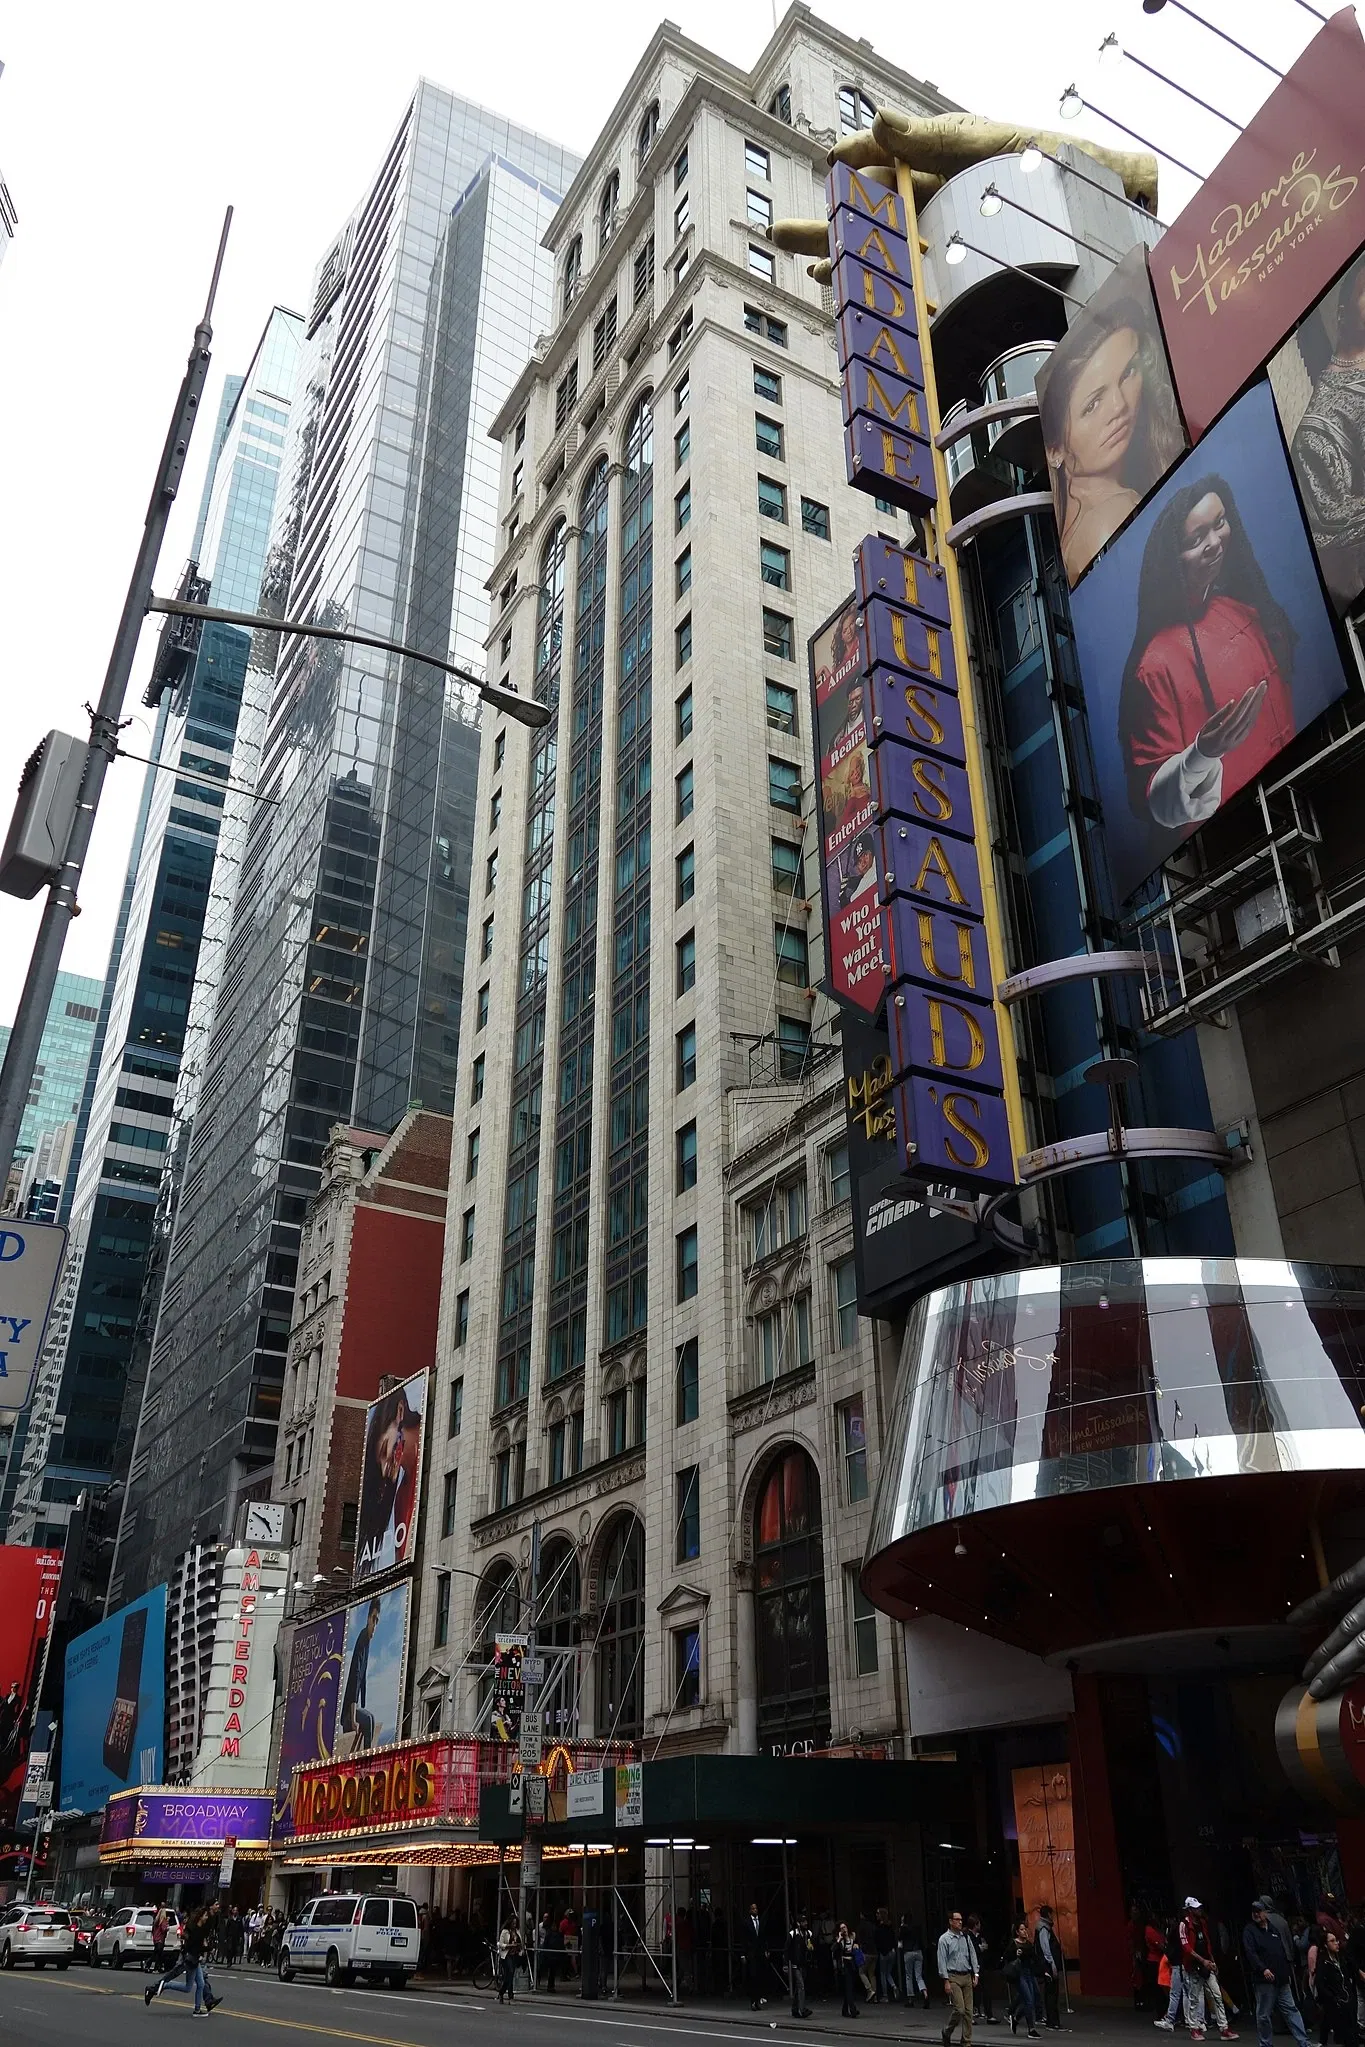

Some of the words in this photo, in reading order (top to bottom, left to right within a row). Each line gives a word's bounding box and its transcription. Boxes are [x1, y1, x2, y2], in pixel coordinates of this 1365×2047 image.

[1170, 148, 1317, 301] Madame
[1182, 164, 1358, 316] Tussauds
[1257, 252, 1285, 283] NEW
[1289, 214, 1323, 250] YORK
[847, 168, 922, 490] MADAME
[830, 721, 868, 768] Realis
[884, 543, 990, 1171] TUSSAUD'S
[840, 904, 870, 934] Who
[855, 913, 881, 942] You
[842, 935, 877, 970] Want
[847, 948, 884, 989] Meet
[40, 1586, 54, 1595] THE
[221, 1550, 260, 1758] AMSTERDAM
[523, 1724, 539, 1733] LANE
[525, 1714, 538, 1723] BUS
[40, 1791, 51, 1799] 25
[295, 1756, 435, 1826] McDonald's
